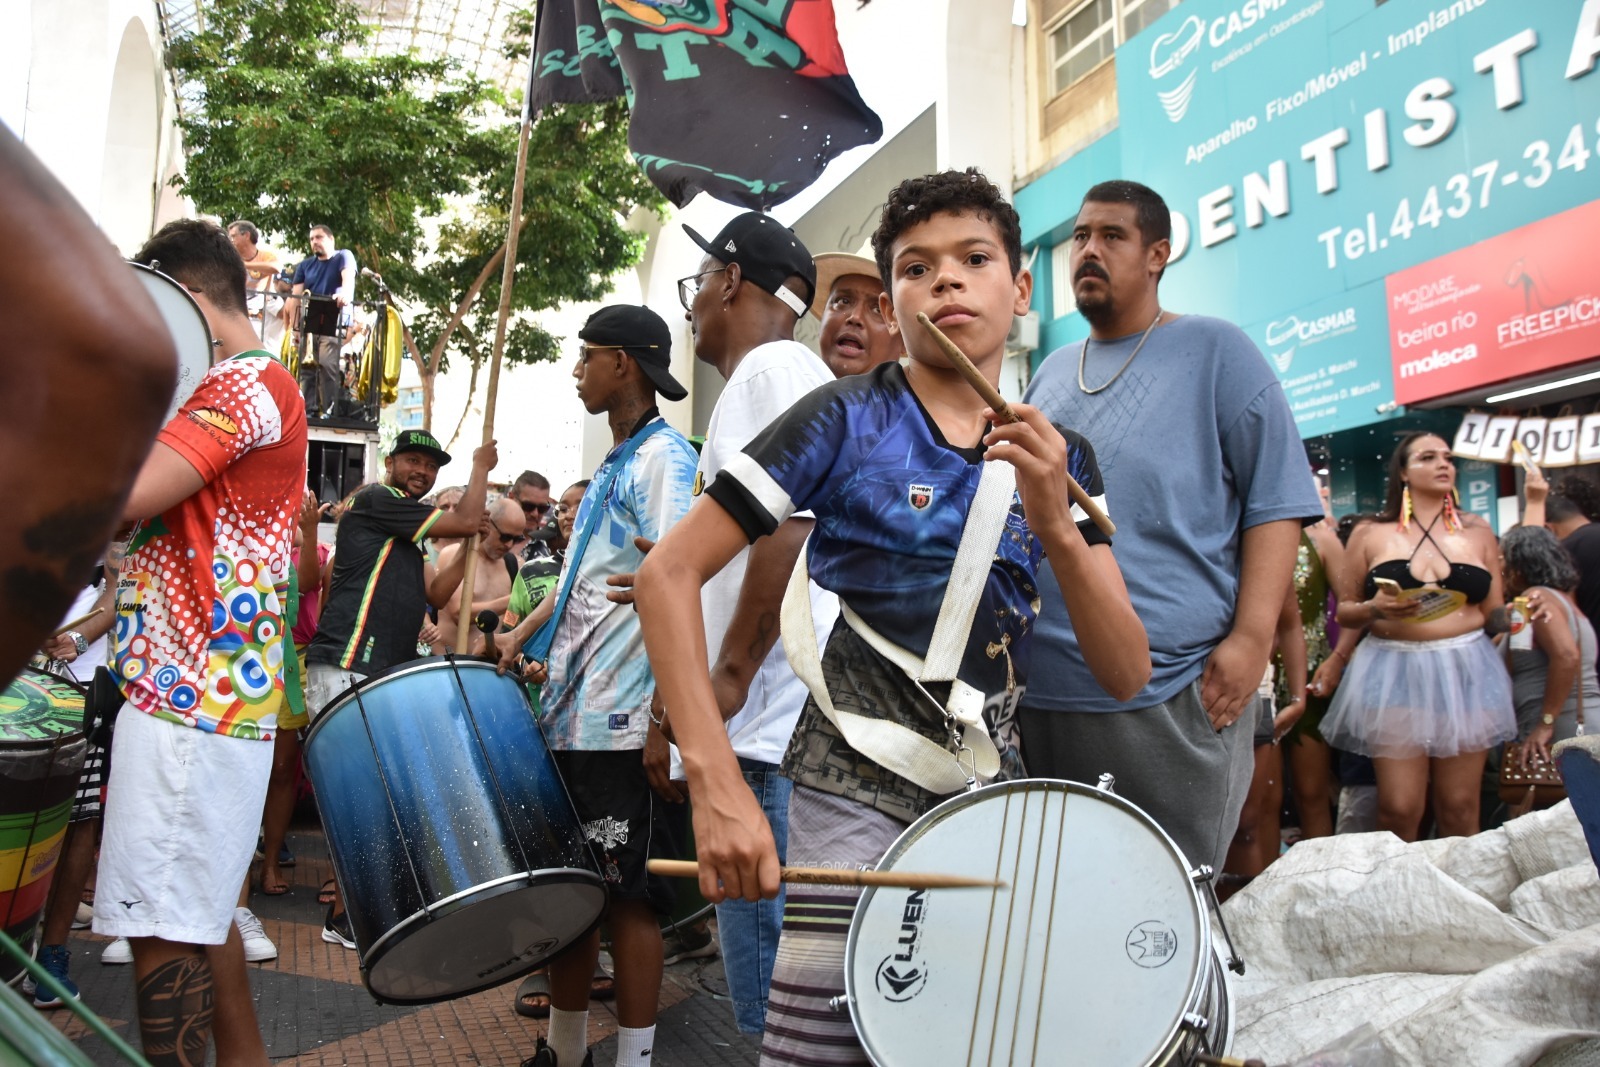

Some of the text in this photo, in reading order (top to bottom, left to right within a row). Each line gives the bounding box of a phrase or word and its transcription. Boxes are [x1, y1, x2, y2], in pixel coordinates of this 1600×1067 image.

[1185, 115, 1258, 166] Aparelho
[1265, 51, 1367, 122] Fixo/Móvel
[1393, 274, 1456, 310] MODARE
[1298, 307, 1357, 340] CASMAR
[1397, 319, 1448, 350] beira
[1451, 310, 1479, 334] rio
[1400, 343, 1479, 379] moleca
